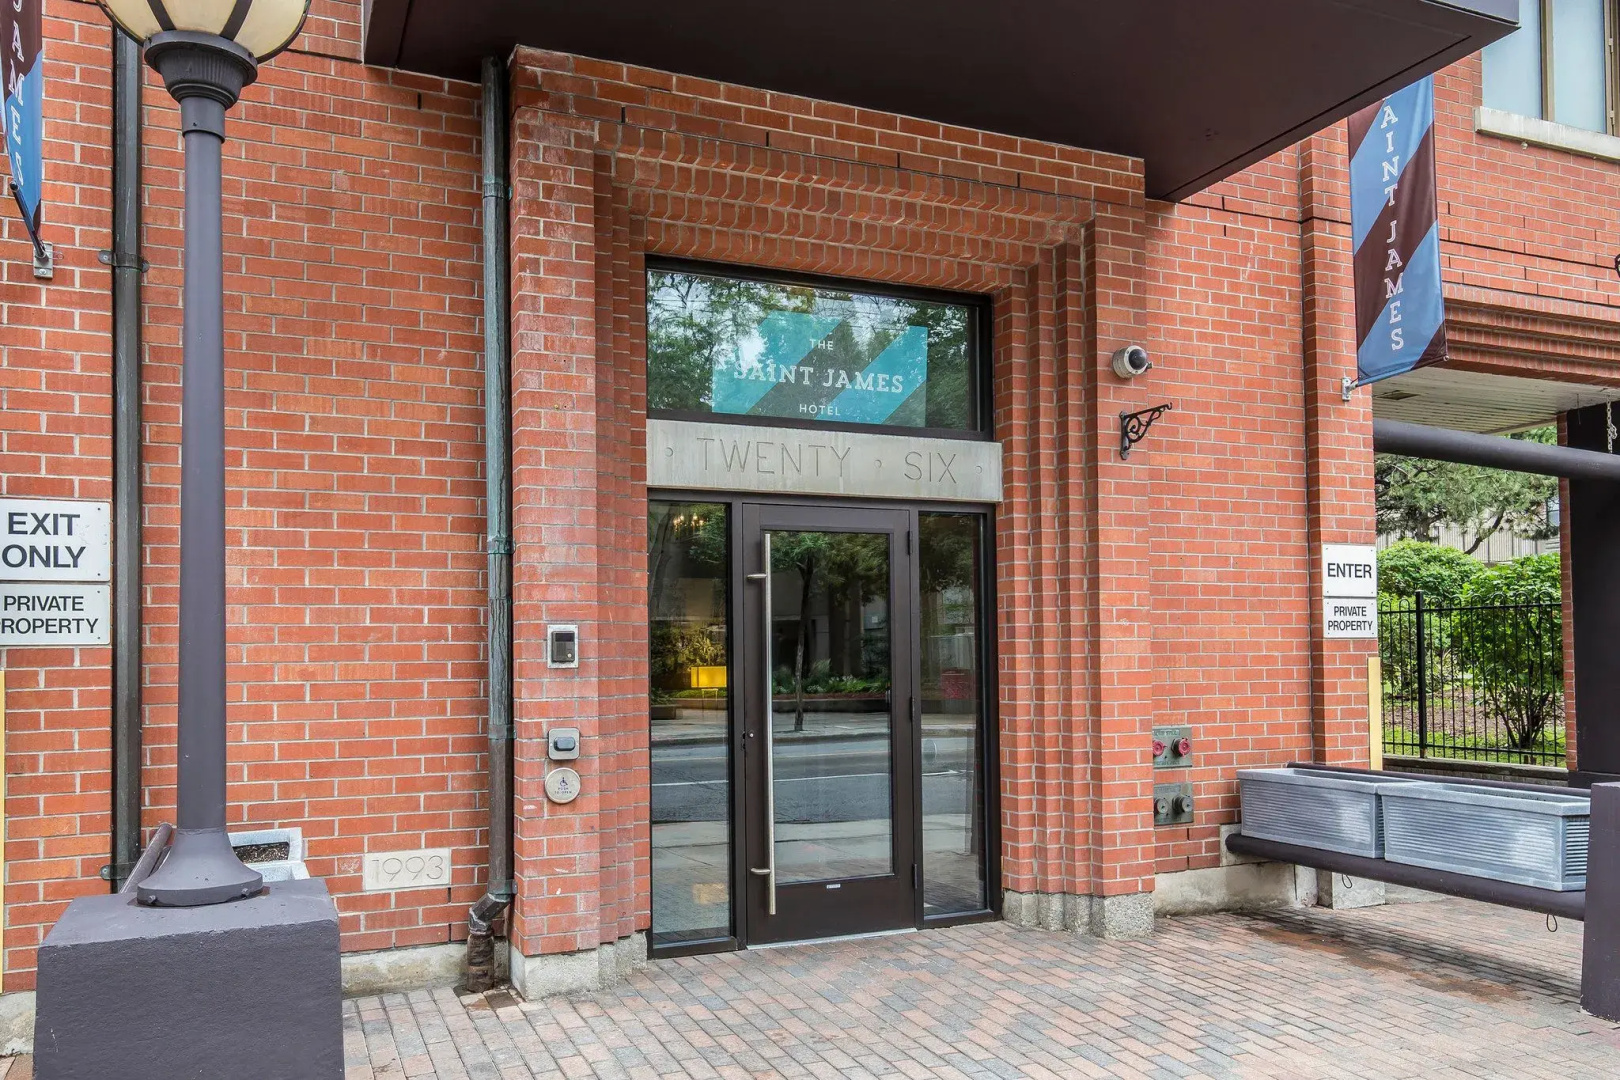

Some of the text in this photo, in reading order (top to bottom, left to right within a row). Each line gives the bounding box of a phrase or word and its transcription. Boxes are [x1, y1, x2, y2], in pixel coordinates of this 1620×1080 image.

[1380, 95, 1404, 351] AINT JAMES
[809, 338, 834, 351] THE
[733, 362, 904, 394] SAINT JAMES
[799, 403, 841, 416] HOTEL
[697, 437, 957, 484] TWENTY SIX
[8, 512, 81, 536] EXIT
[1, 544, 87, 568] ONLY
[1327, 562, 1372, 579] ENTER
[3, 595, 84, 612] PRIVATE
[1333, 605, 1367, 617] PRIVATE
[0, 618, 99, 634] ROPERTY
[1327, 620, 1373, 631] PROPERTY
[371, 855, 443, 884] 1993
